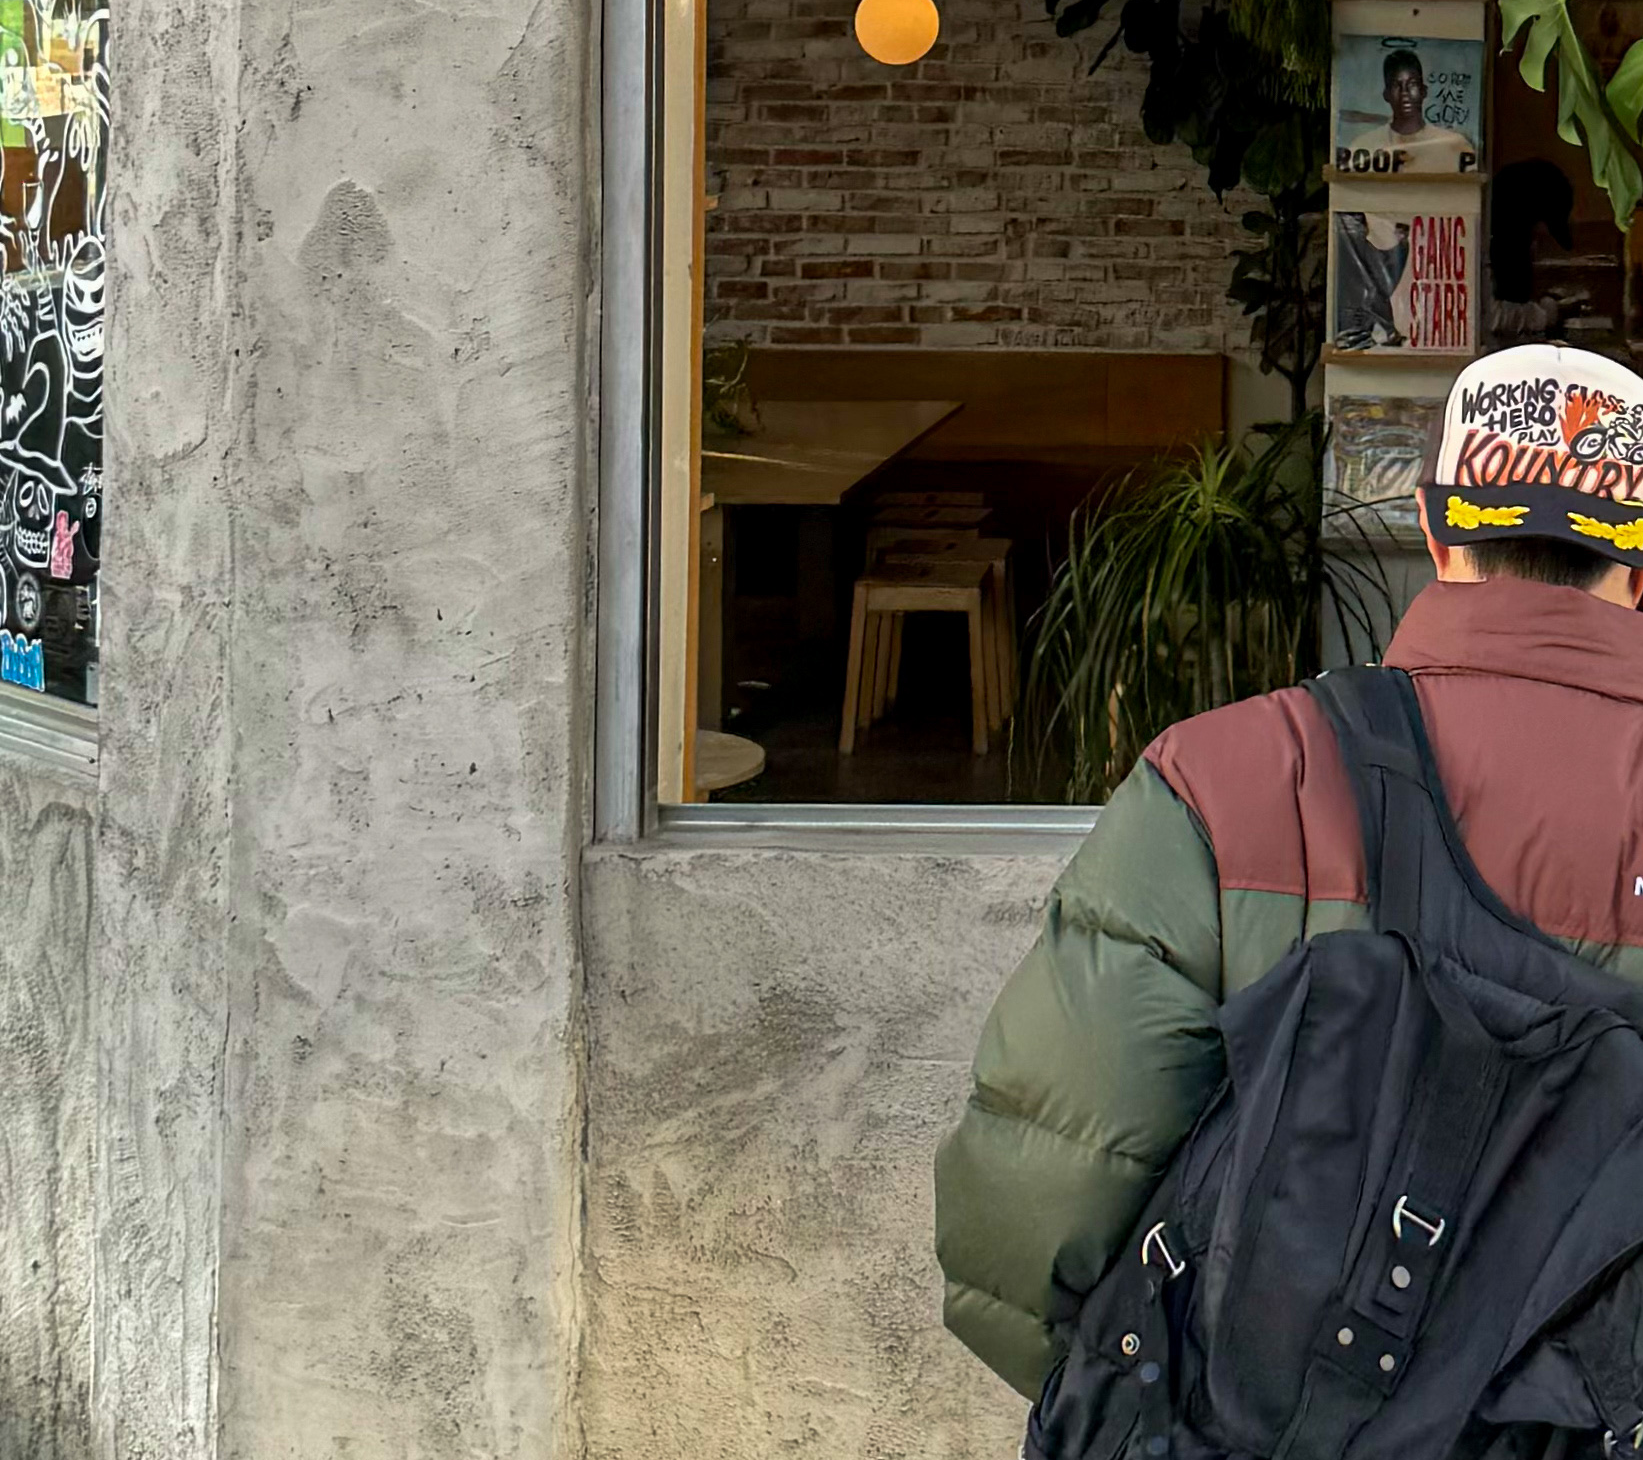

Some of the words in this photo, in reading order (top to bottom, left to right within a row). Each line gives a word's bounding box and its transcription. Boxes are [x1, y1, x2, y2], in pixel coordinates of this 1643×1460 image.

[1411, 215, 1467, 280] GANG
[1410, 282, 1468, 347] STARR
[1461, 378, 1559, 424] WORKING
[1482, 402, 1557, 433] HERO
[1517, 428, 1557, 445] PLAY
